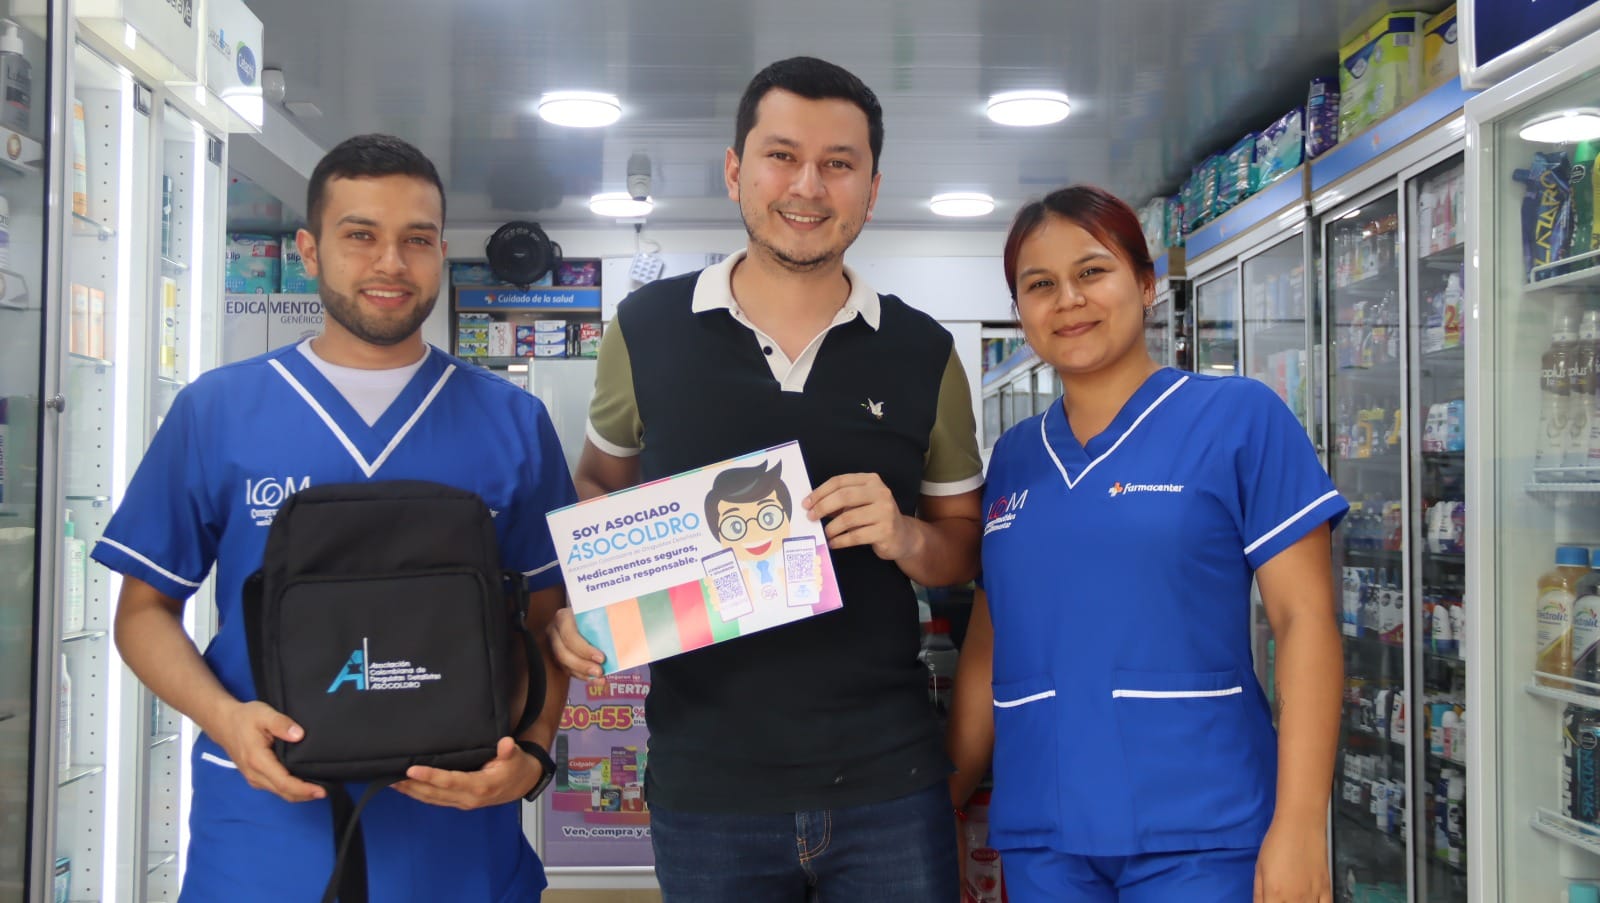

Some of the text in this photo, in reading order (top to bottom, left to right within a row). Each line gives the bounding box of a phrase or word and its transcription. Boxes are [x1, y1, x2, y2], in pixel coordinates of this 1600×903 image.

[498, 294, 574, 303] Cuidado de la salud
[1123, 482, 1185, 495] farmacenter
[572, 502, 681, 541] SOY ASOCIADO
[567, 512, 700, 566] ASOCOLDRO
[577, 545, 698, 583] Medicamentos seguros,
[586, 574, 631, 593] farmacia
[633, 556, 698, 580] responsable.
[369, 666, 427, 676] Colombiana de
[371, 681, 421, 690] ASOCOLDRO
[600, 705, 633, 730] 55
[562, 827, 589, 837] Ven,
[591, 827, 633, 838] compra
[634, 828, 643, 838] y
